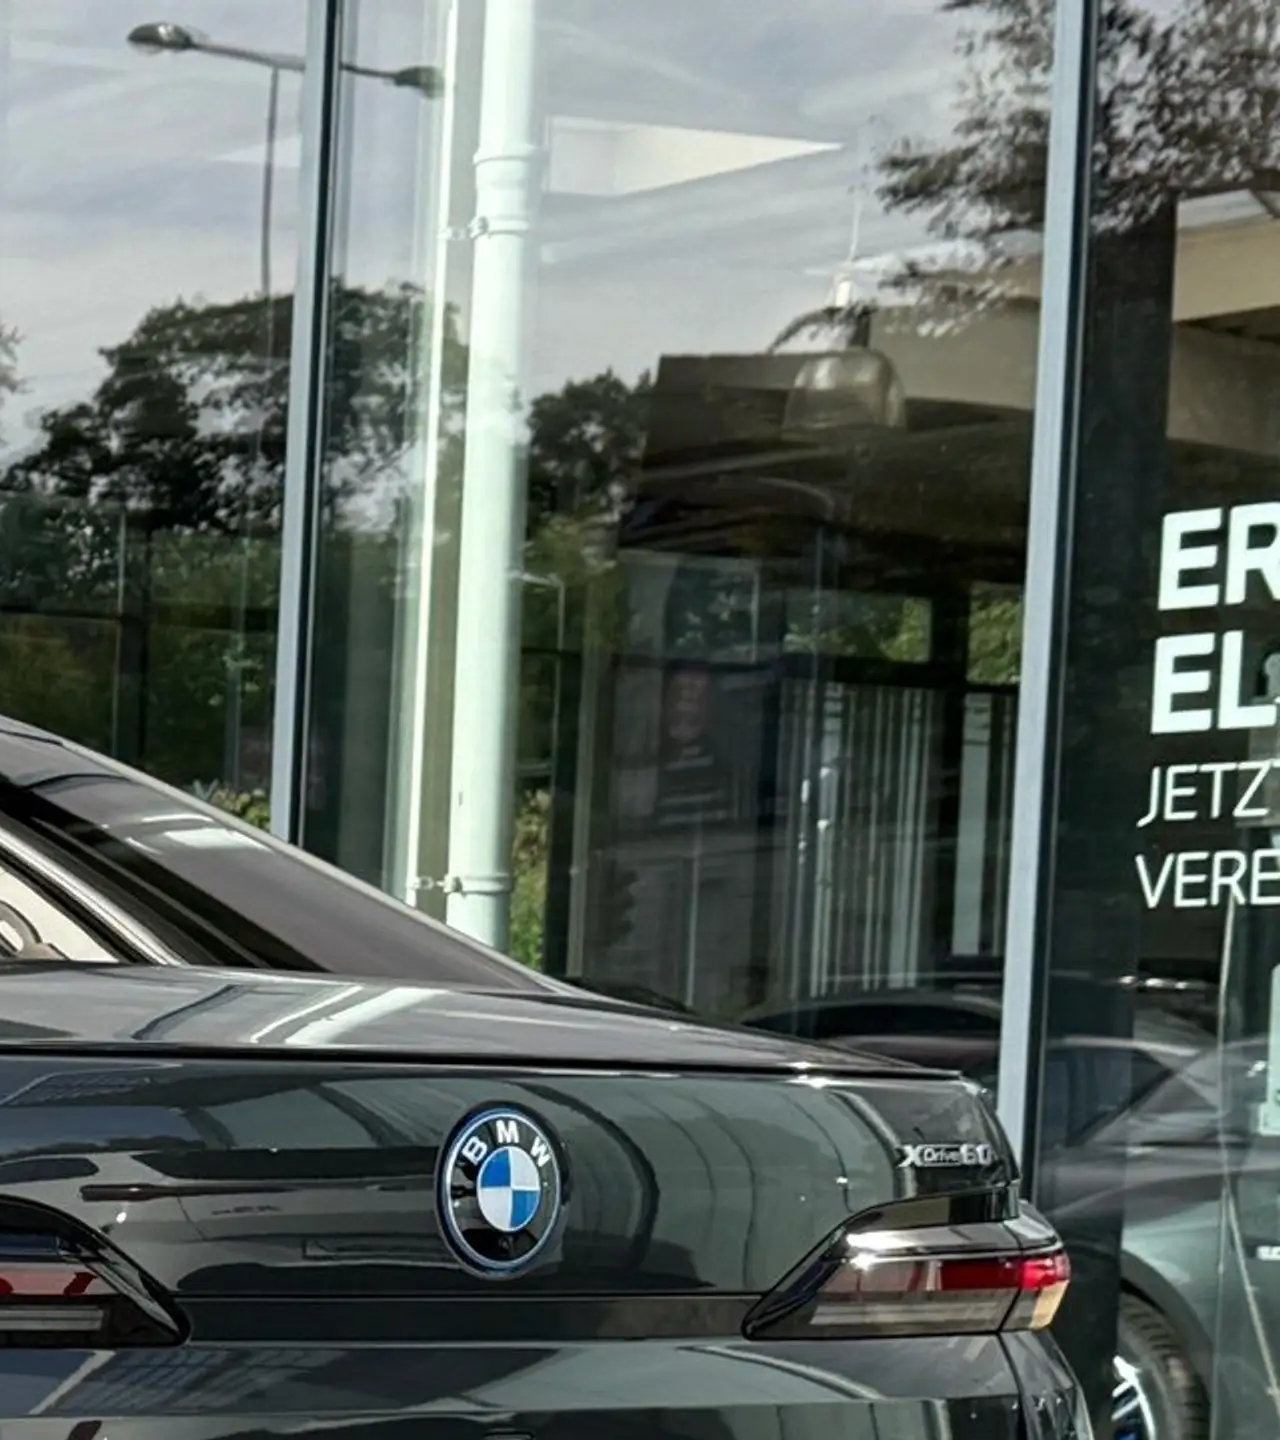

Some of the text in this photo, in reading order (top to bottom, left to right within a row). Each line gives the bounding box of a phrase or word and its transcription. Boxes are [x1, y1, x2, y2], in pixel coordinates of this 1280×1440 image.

[1158, 502, 1280, 610] ER
[1151, 630, 1280, 734] EL
[1137, 762, 1280, 827] JETZ
[1135, 848, 1280, 909] VERE
[462, 1120, 551, 1168] BMW
